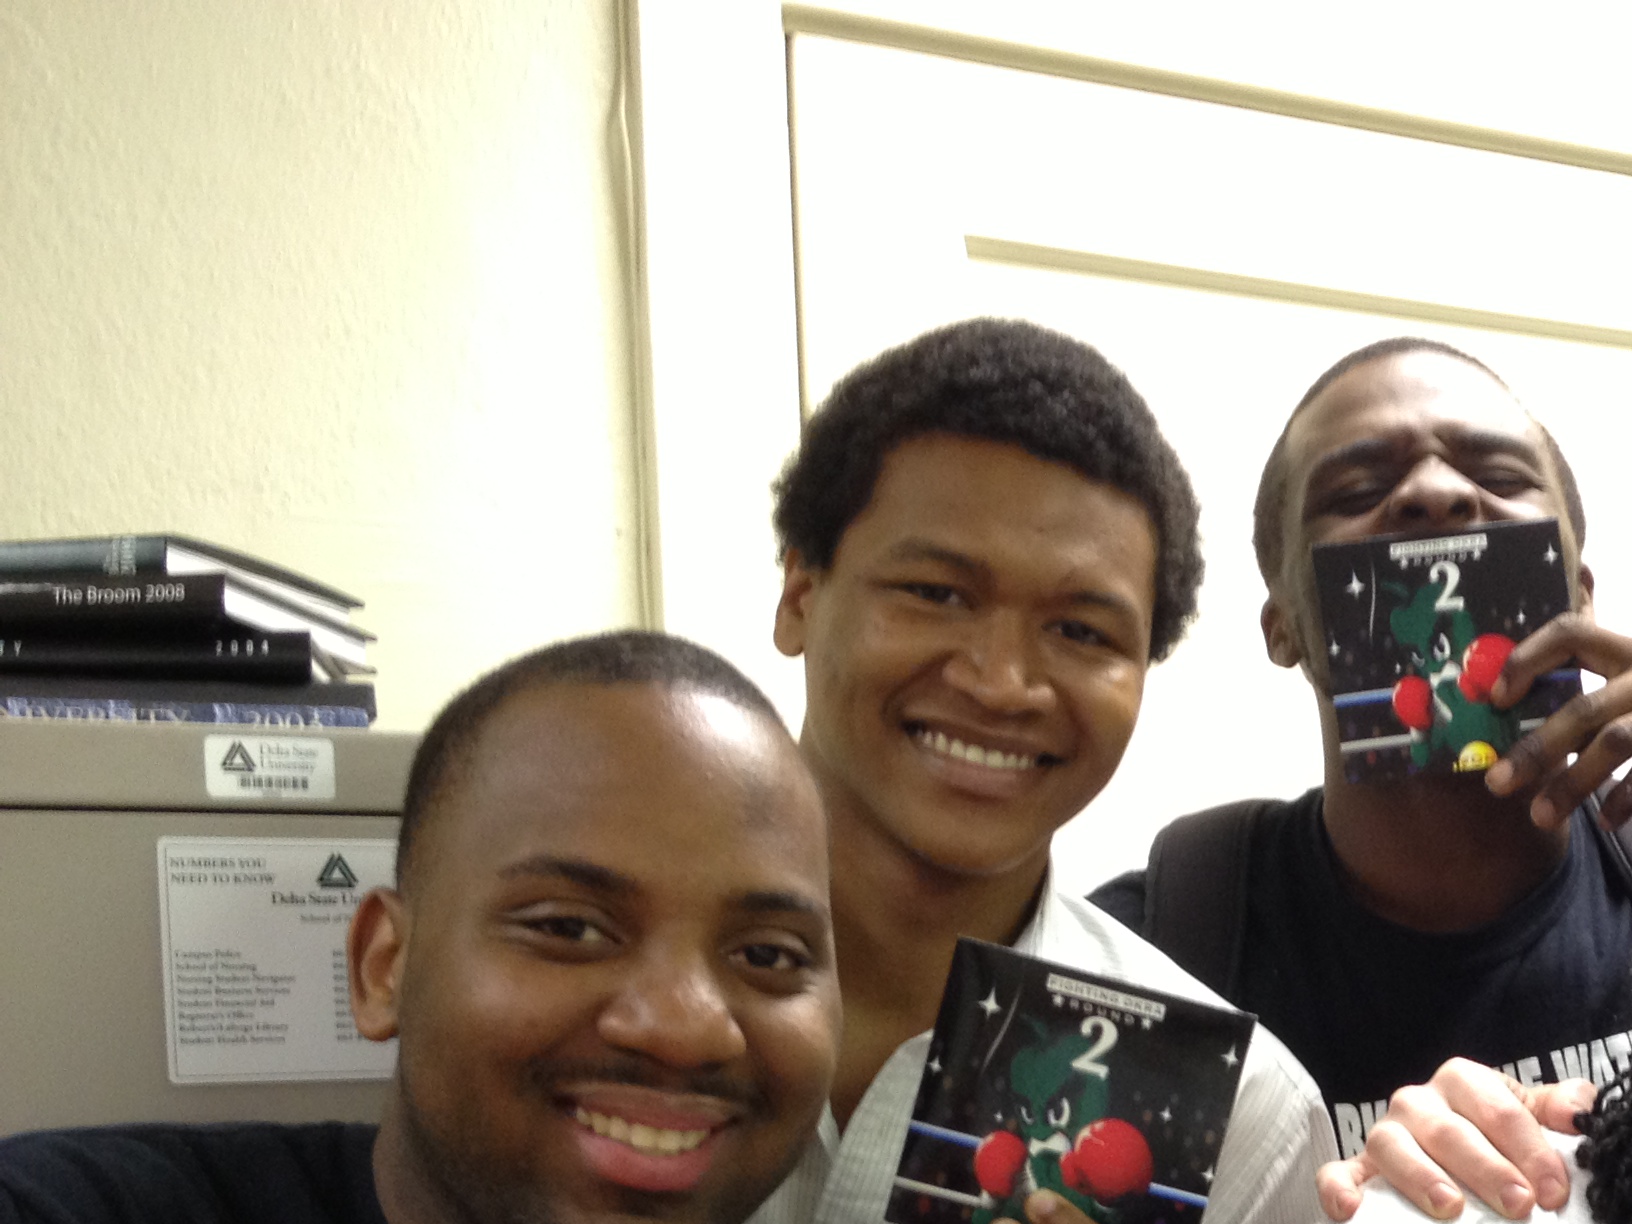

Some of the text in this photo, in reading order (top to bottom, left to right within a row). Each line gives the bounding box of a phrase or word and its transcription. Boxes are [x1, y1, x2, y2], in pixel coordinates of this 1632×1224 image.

[53, 583, 185, 605] The Broom 2008
[1429, 560, 1464, 612] 2
[170, 857, 267, 868] NUMBERS YOU
[171, 873, 276, 884] NEED TO KNOW
[272, 891, 306, 904] Delta
[1070, 1016, 1119, 1081] 2
